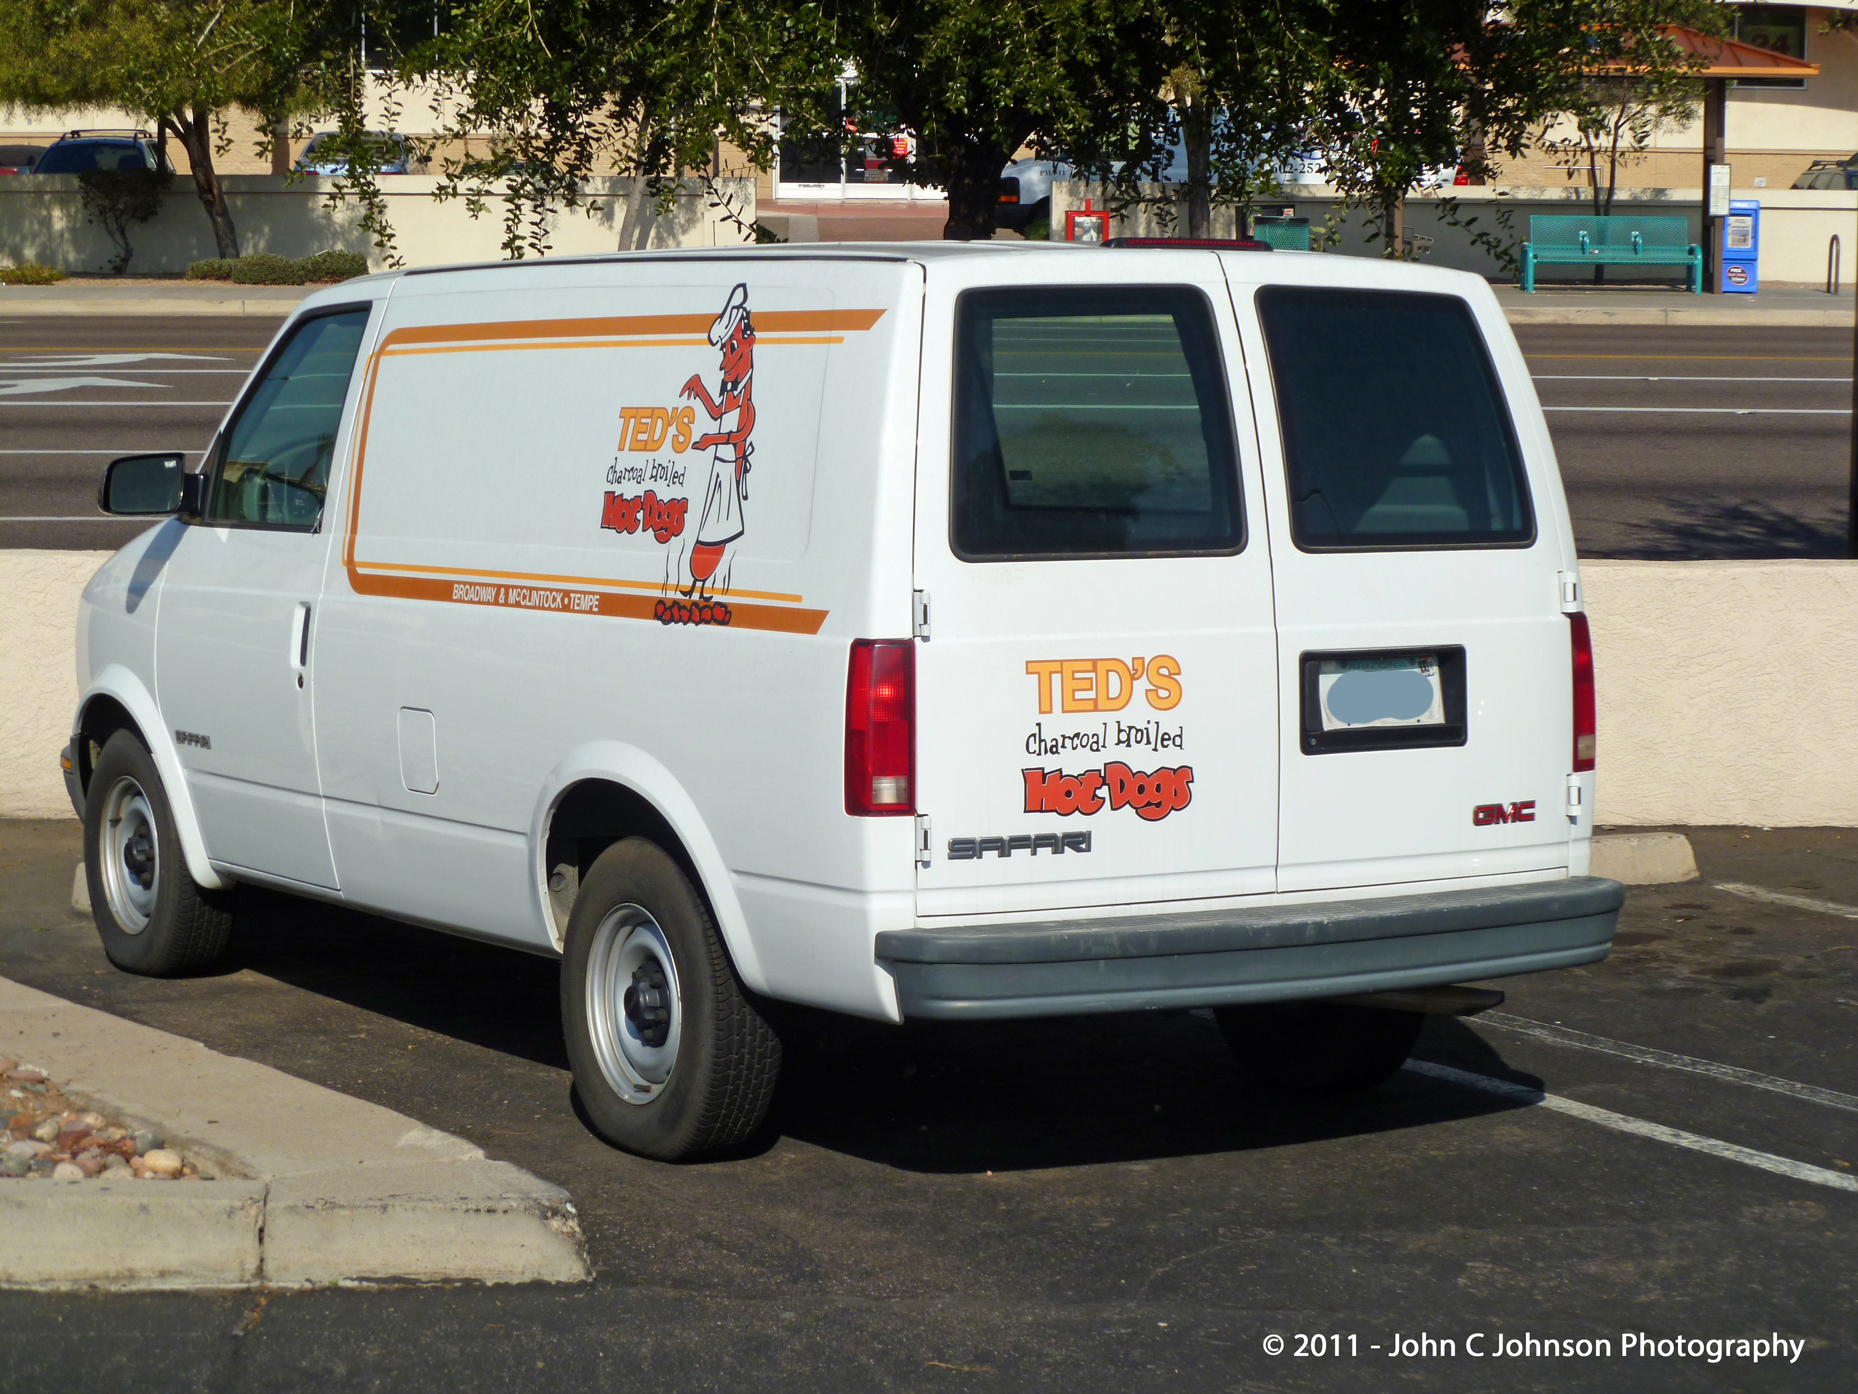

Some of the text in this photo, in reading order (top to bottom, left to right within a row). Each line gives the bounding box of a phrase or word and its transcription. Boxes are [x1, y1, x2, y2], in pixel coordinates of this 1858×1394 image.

[617, 405, 695, 454] TED'S
[606, 456, 687, 487] charcoal broiled
[601, 489, 688, 544] Hot Dogs
[452, 583, 498, 603] BROADWAY
[498, 587, 505, 604] &
[569, 593, 600, 612] TEMPE
[1348, 660, 1407, 670] ARIZONA
[1025, 654, 1183, 714] TED'S
[1025, 720, 1185, 757] charcoal broiled
[1021, 761, 1194, 822] Hot Dogs
[1473, 800, 1536, 826] GMC
[948, 830, 1092, 860] SAFARI
